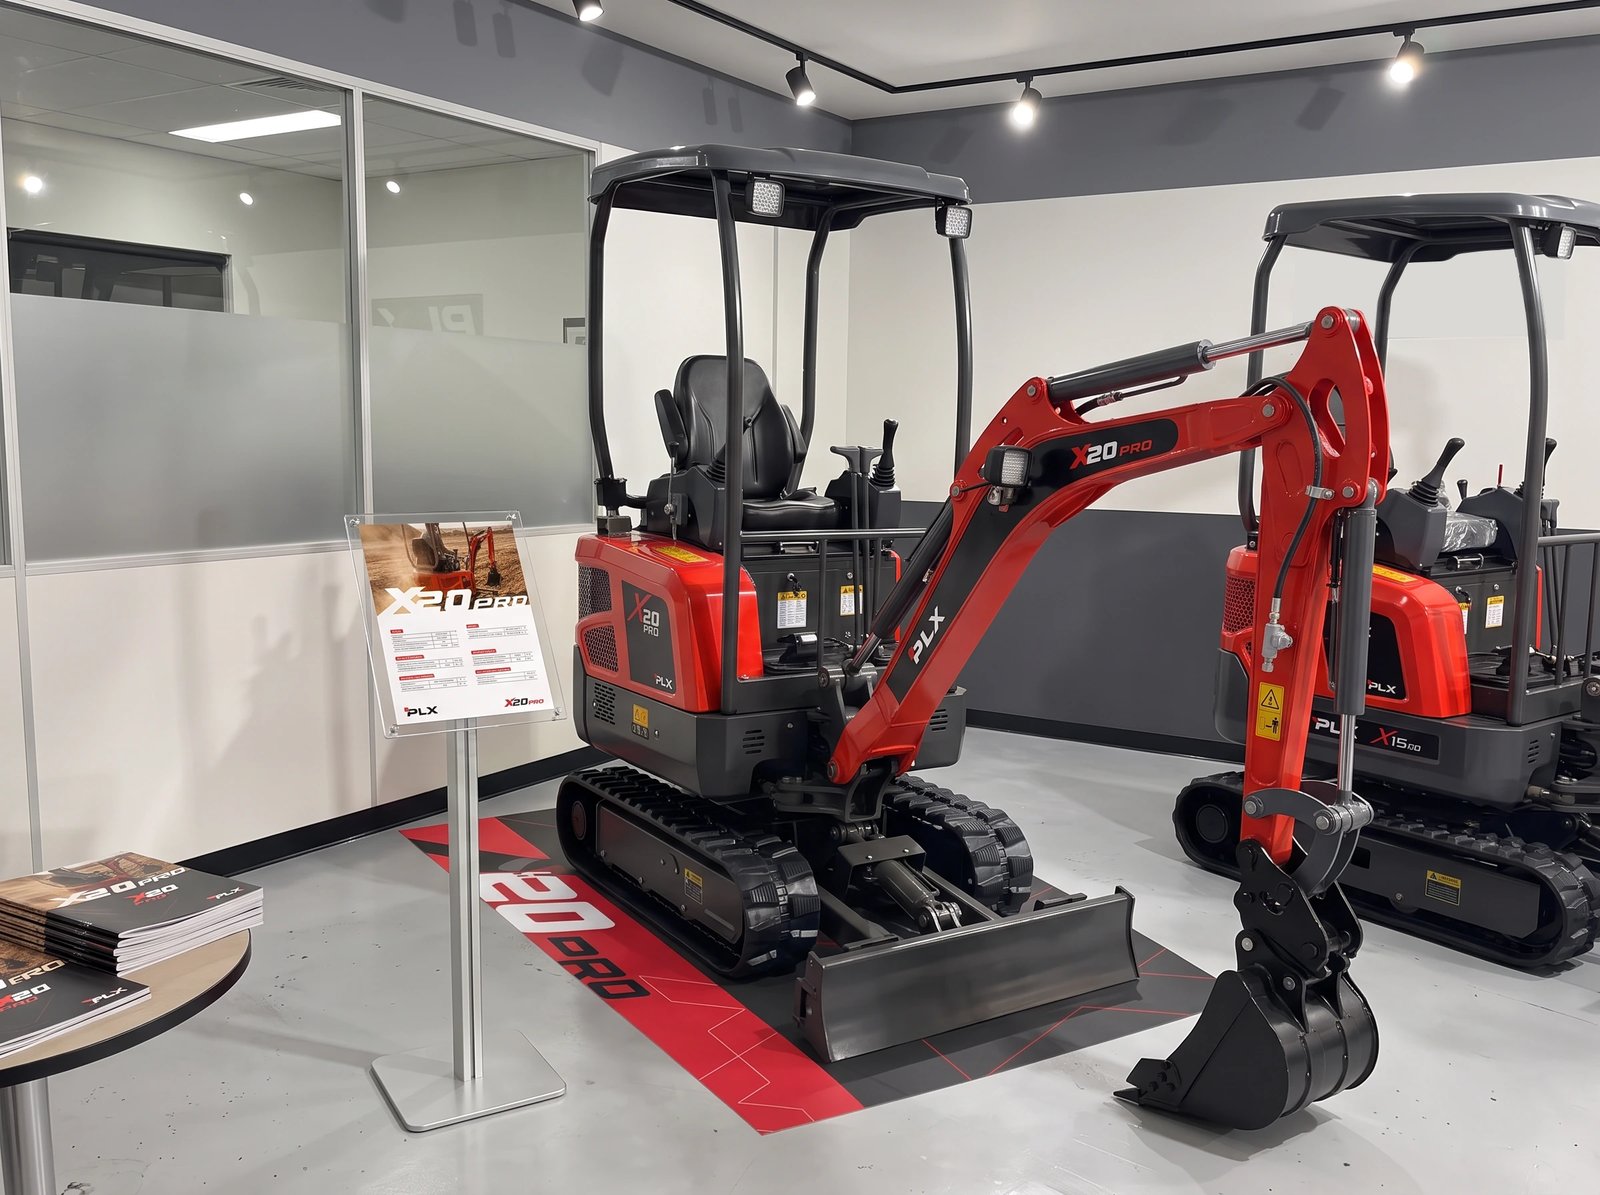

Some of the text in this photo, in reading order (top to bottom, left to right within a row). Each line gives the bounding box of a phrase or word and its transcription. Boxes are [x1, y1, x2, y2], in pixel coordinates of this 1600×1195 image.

[1069, 440, 1152, 469] X20 PRO
[643, 624, 659, 637] PRO
[911, 605, 946, 665] PLX
[655, 675, 673, 690] PLX
[1368, 681, 1397, 695] PLX
[504, 697, 544, 708] X20 PRO
[406, 705, 438, 717] PLX
